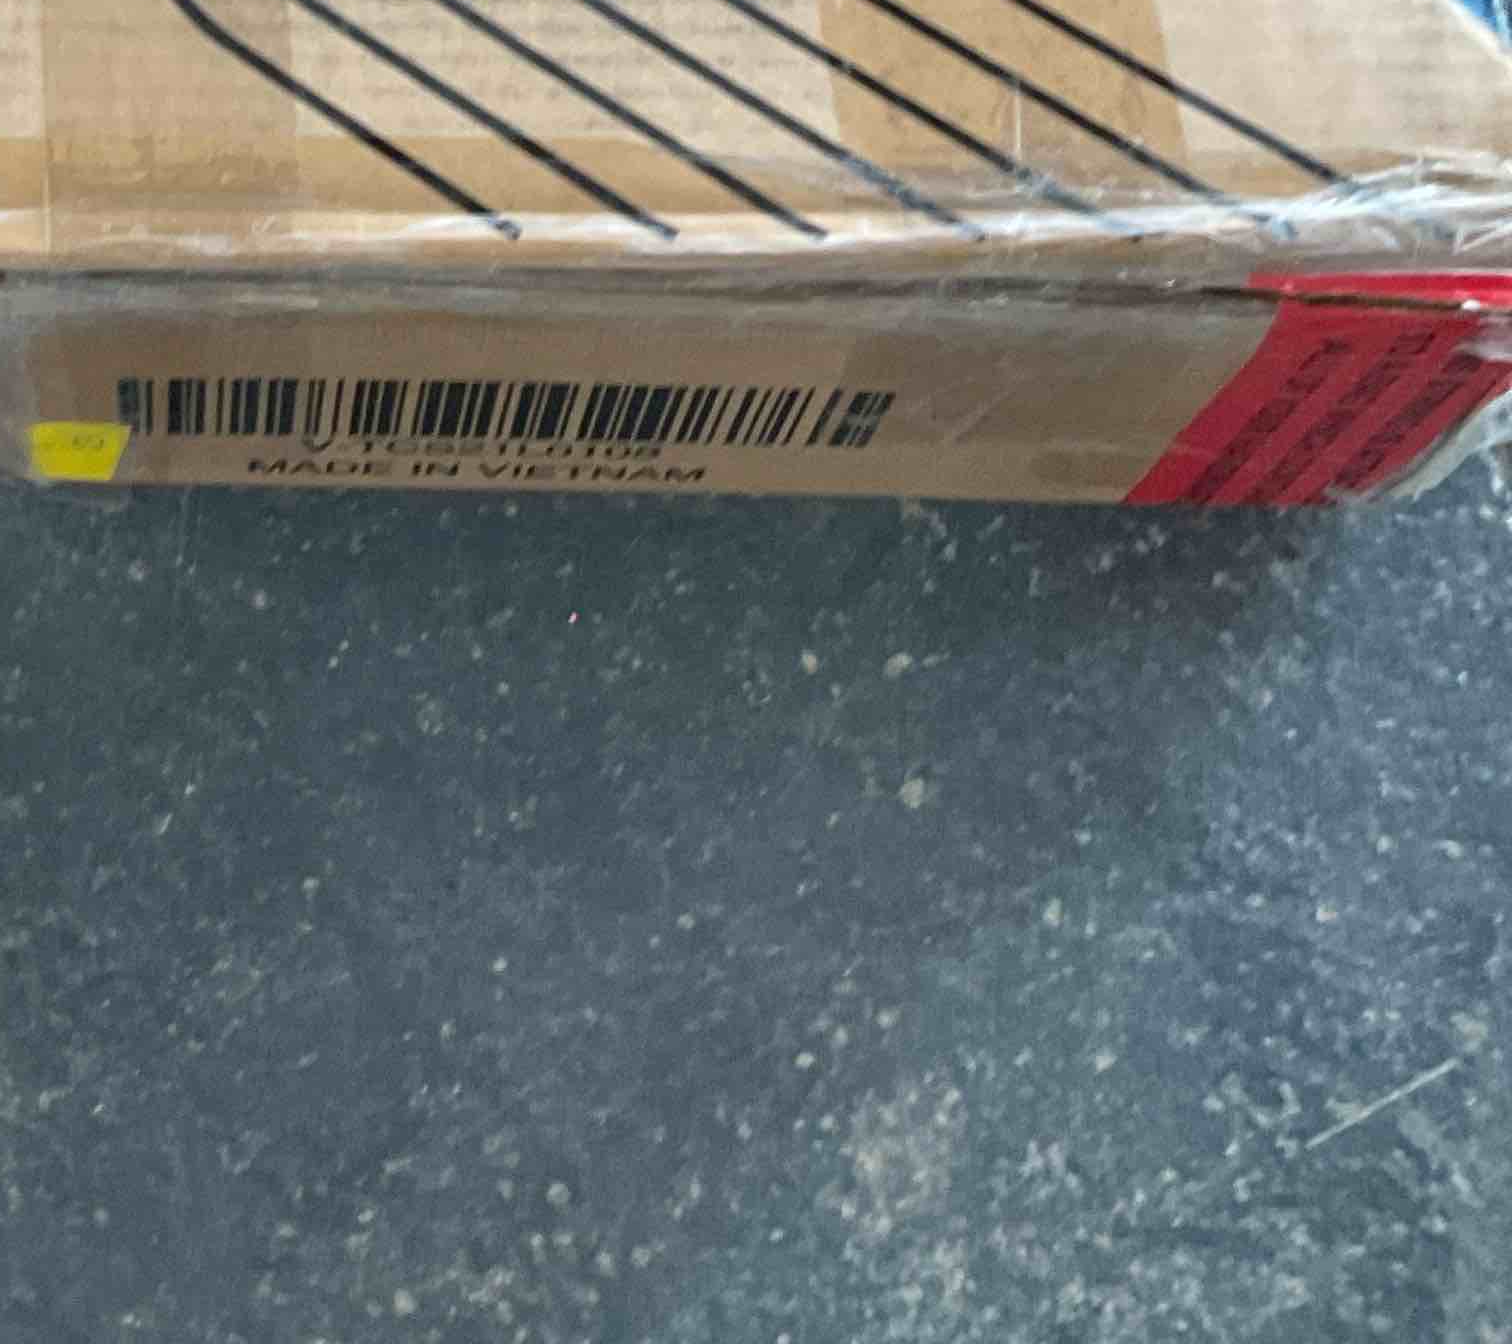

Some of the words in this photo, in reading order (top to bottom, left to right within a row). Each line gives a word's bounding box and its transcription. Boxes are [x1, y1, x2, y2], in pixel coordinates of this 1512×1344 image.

[248, 459, 389, 476] MADE
[412, 462, 460, 478] IN
[479, 462, 707, 483] VIETNAM
